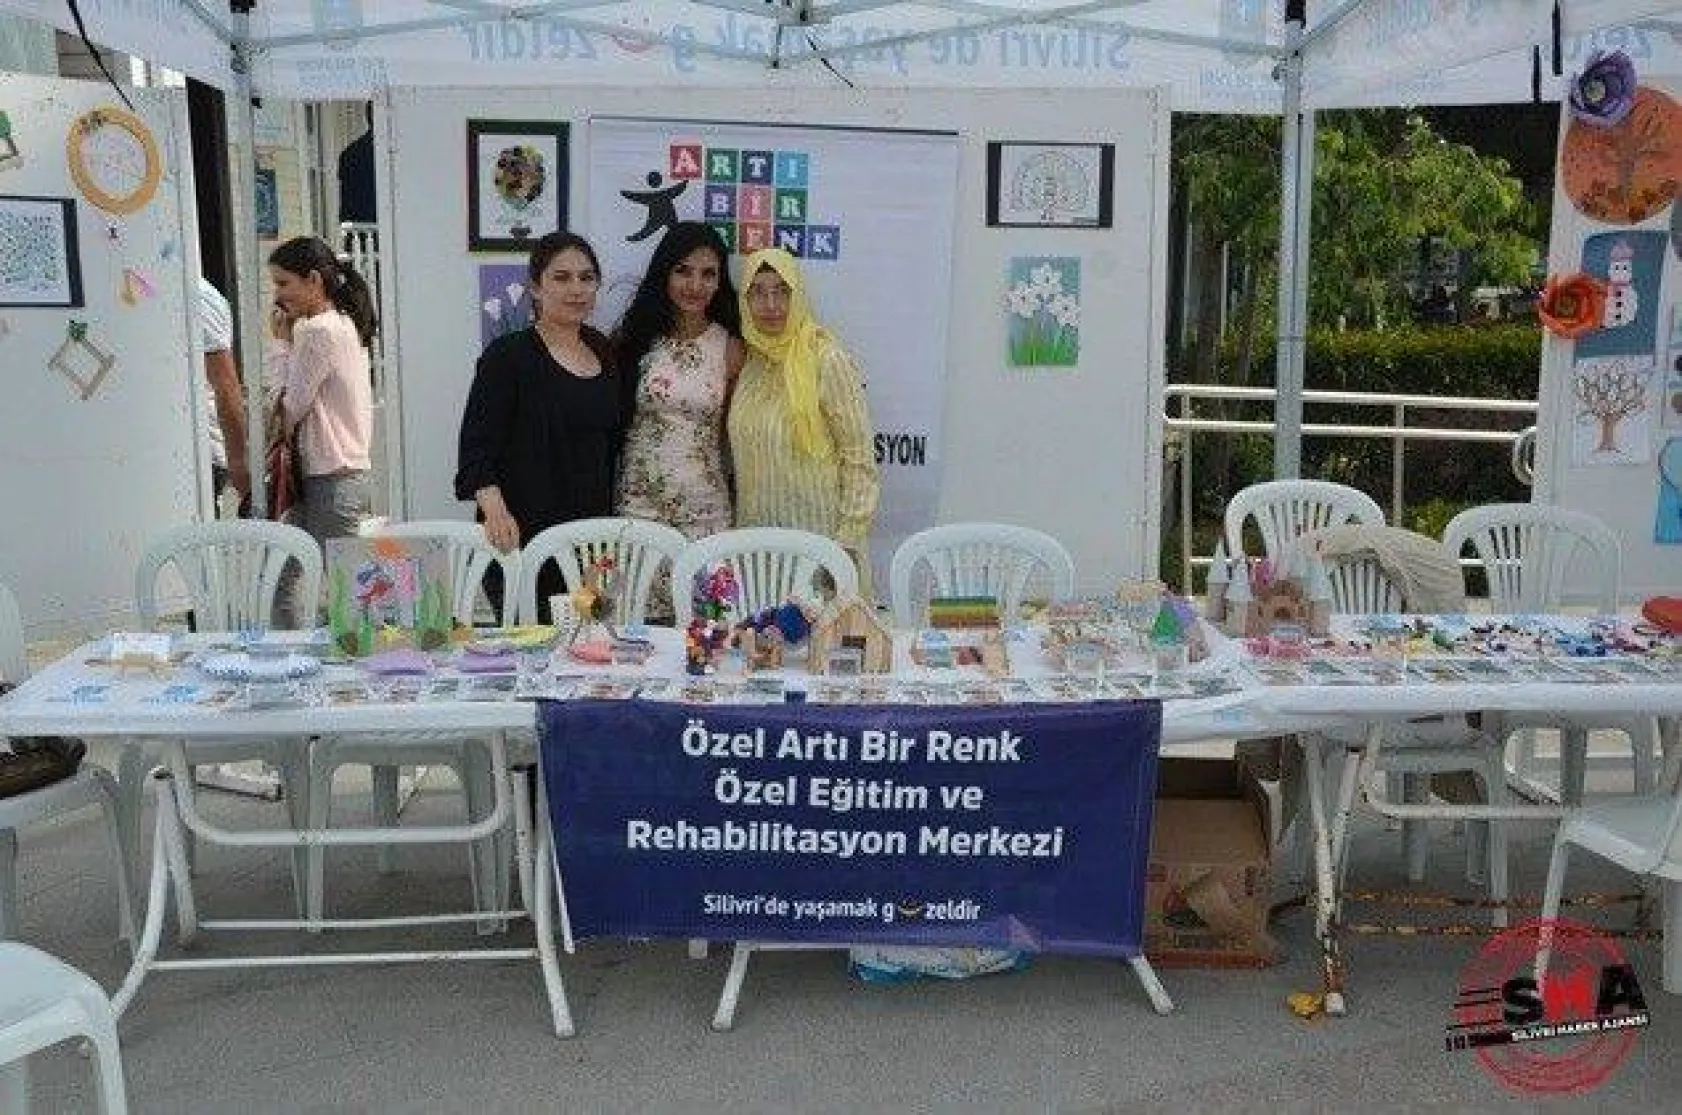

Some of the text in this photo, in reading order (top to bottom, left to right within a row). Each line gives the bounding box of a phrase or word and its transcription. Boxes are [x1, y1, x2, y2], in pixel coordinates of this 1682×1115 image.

[682, 720, 1021, 762] Özel Artı Bir Renk
[715, 769, 984, 812] Özel Eğitim ve
[627, 820, 1063, 859] Rehabilitasyon Merkezi
[794, 898, 878, 922] yaşamak
